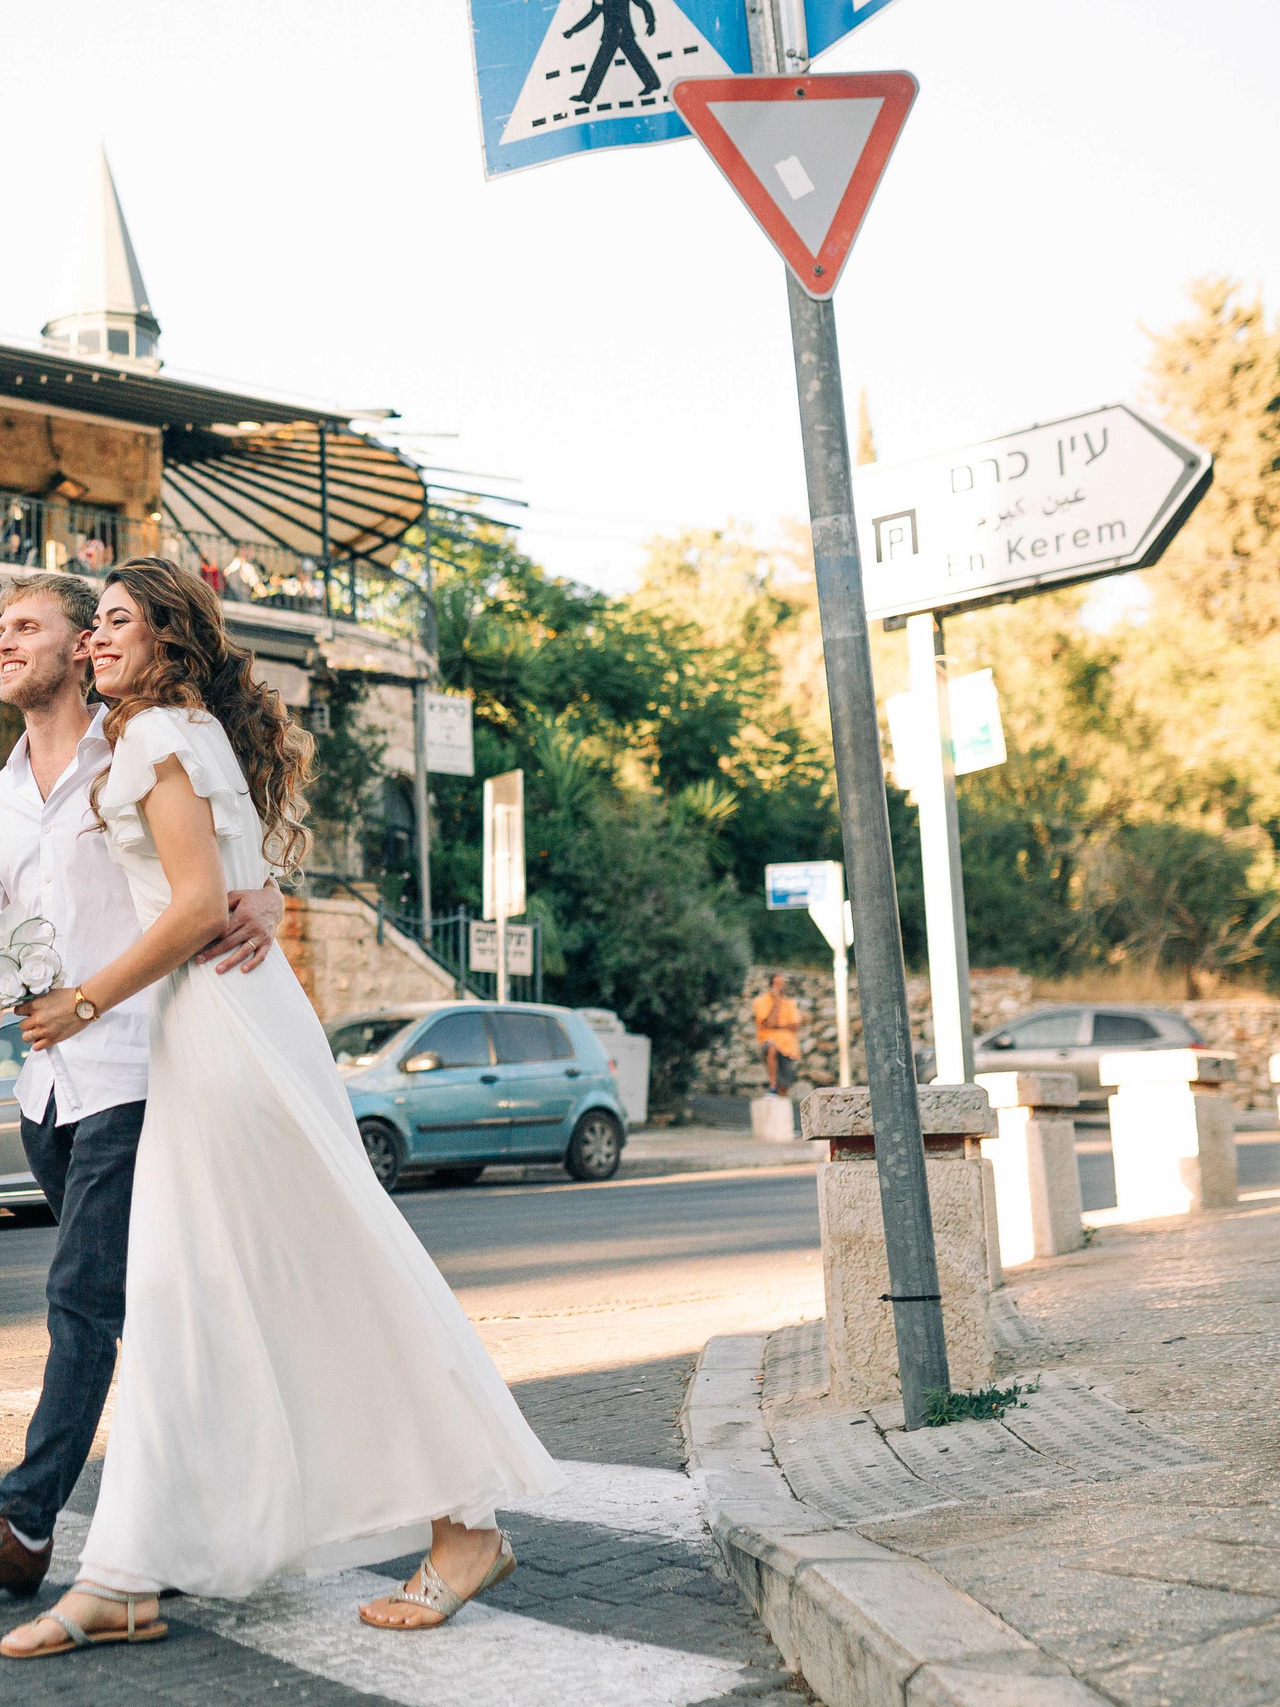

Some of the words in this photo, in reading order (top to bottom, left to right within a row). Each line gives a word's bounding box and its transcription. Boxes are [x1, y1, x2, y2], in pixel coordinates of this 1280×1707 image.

[950, 450, 1030, 494] כרם
[1057, 428, 1109, 477] עין
[1006, 519, 1127, 565] Kerem
